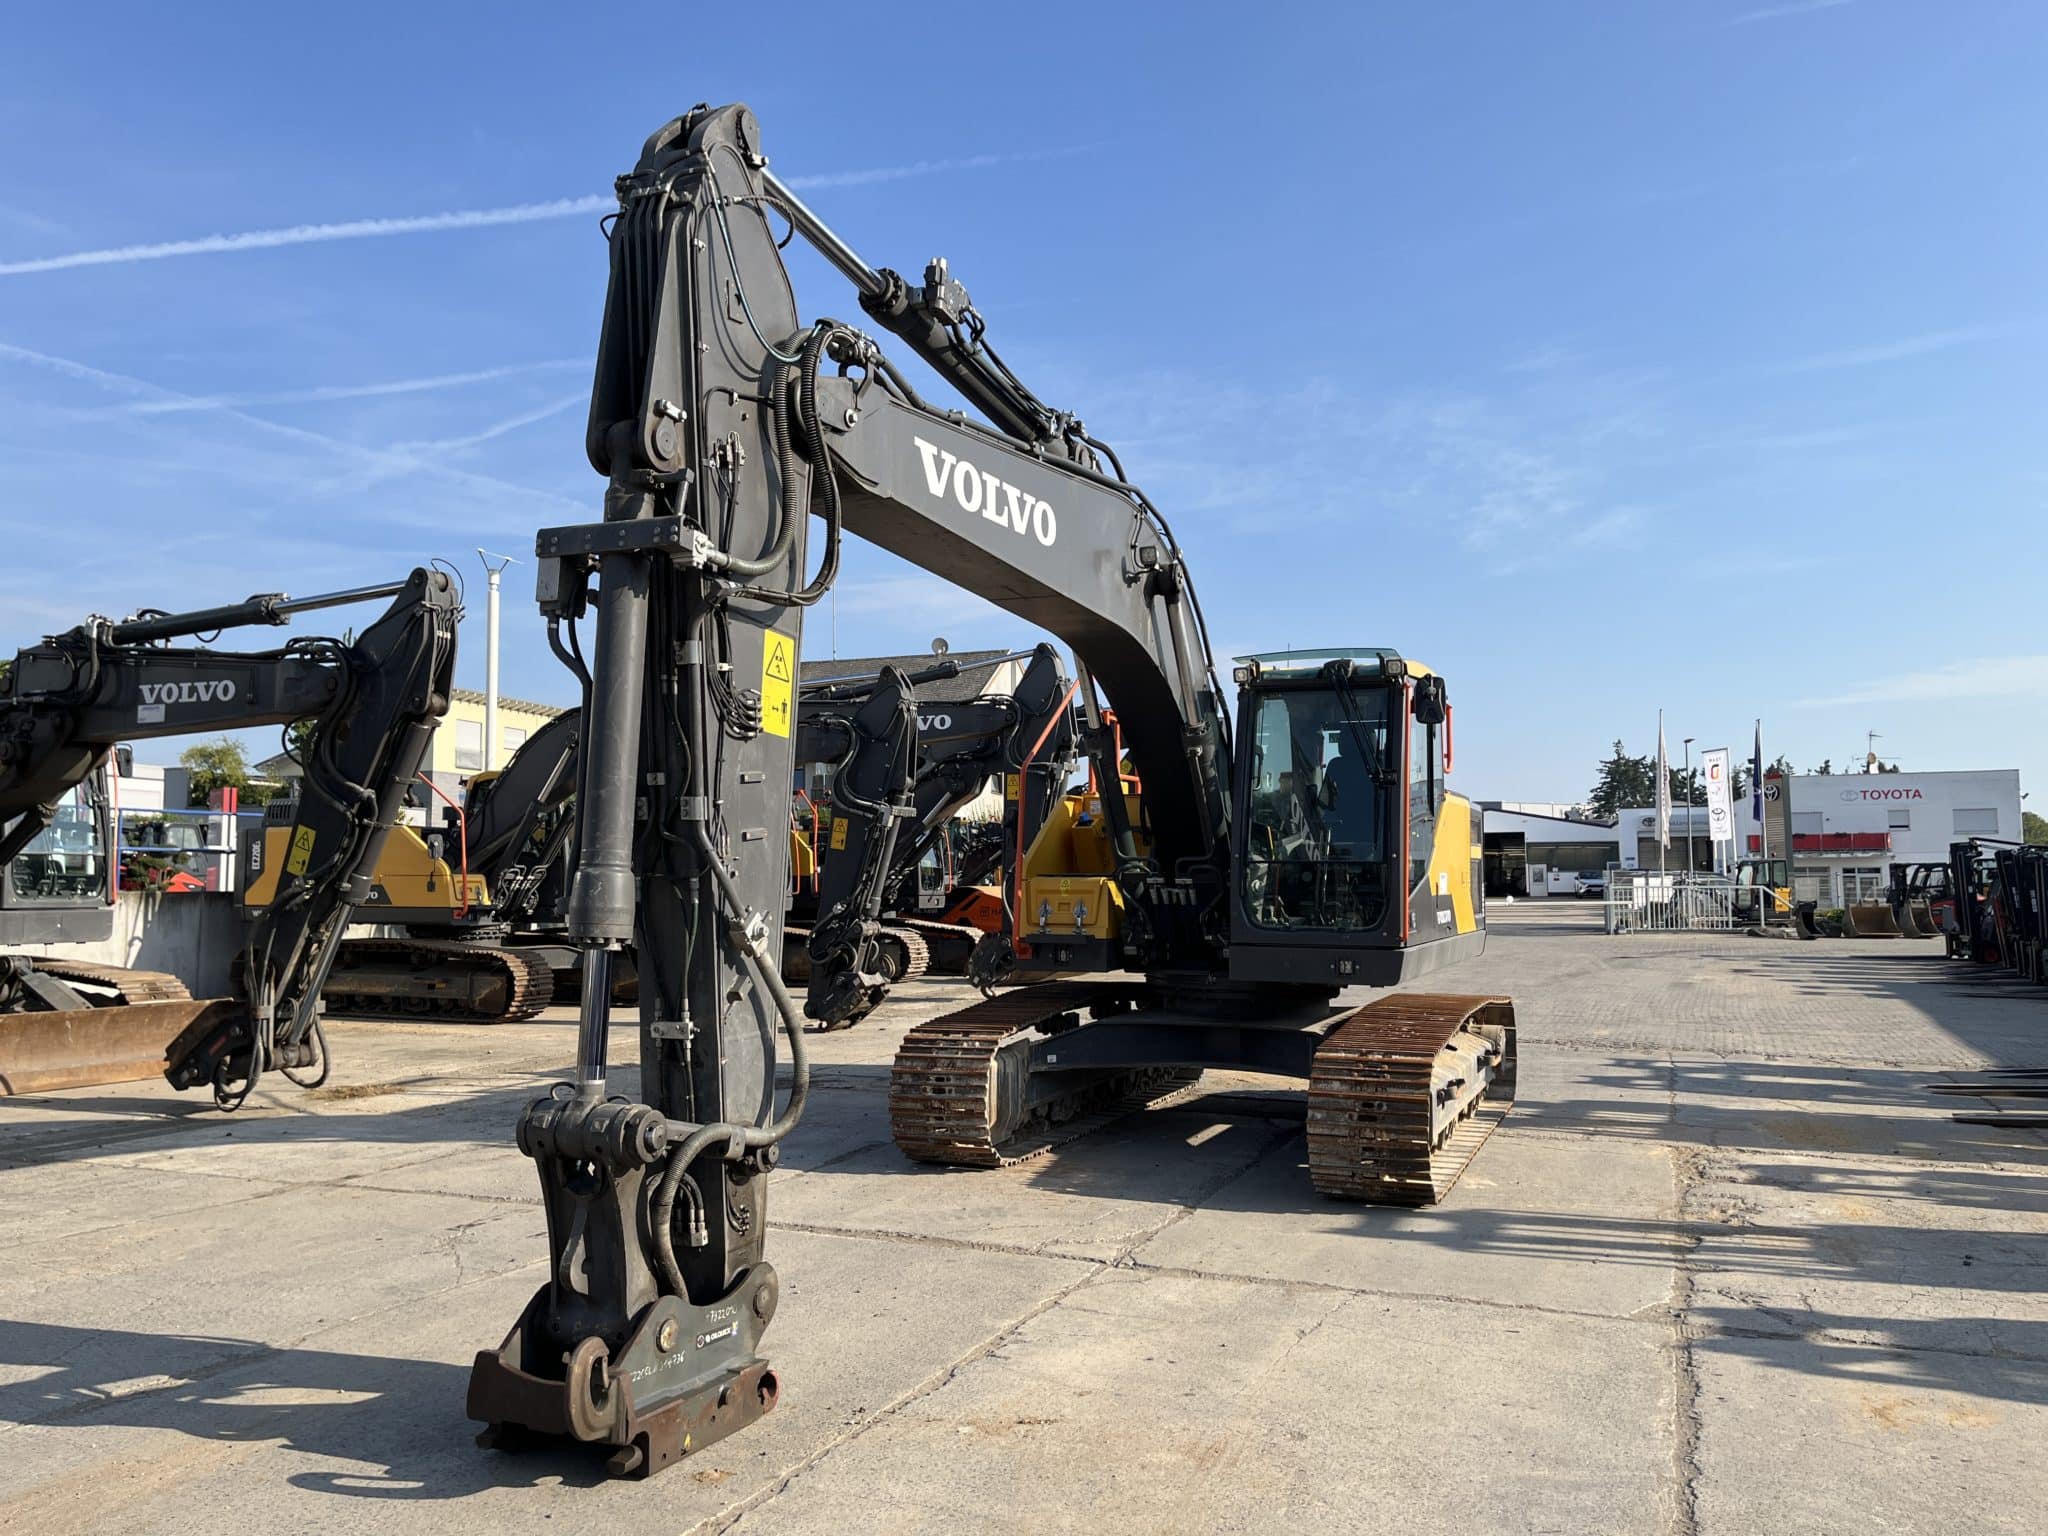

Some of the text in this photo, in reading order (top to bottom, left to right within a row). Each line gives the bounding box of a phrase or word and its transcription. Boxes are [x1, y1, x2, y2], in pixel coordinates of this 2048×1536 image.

[914, 436, 1057, 547] VOLVO
[139, 680, 236, 704] VOLVO
[1860, 788, 1922, 801] TOYOTA
